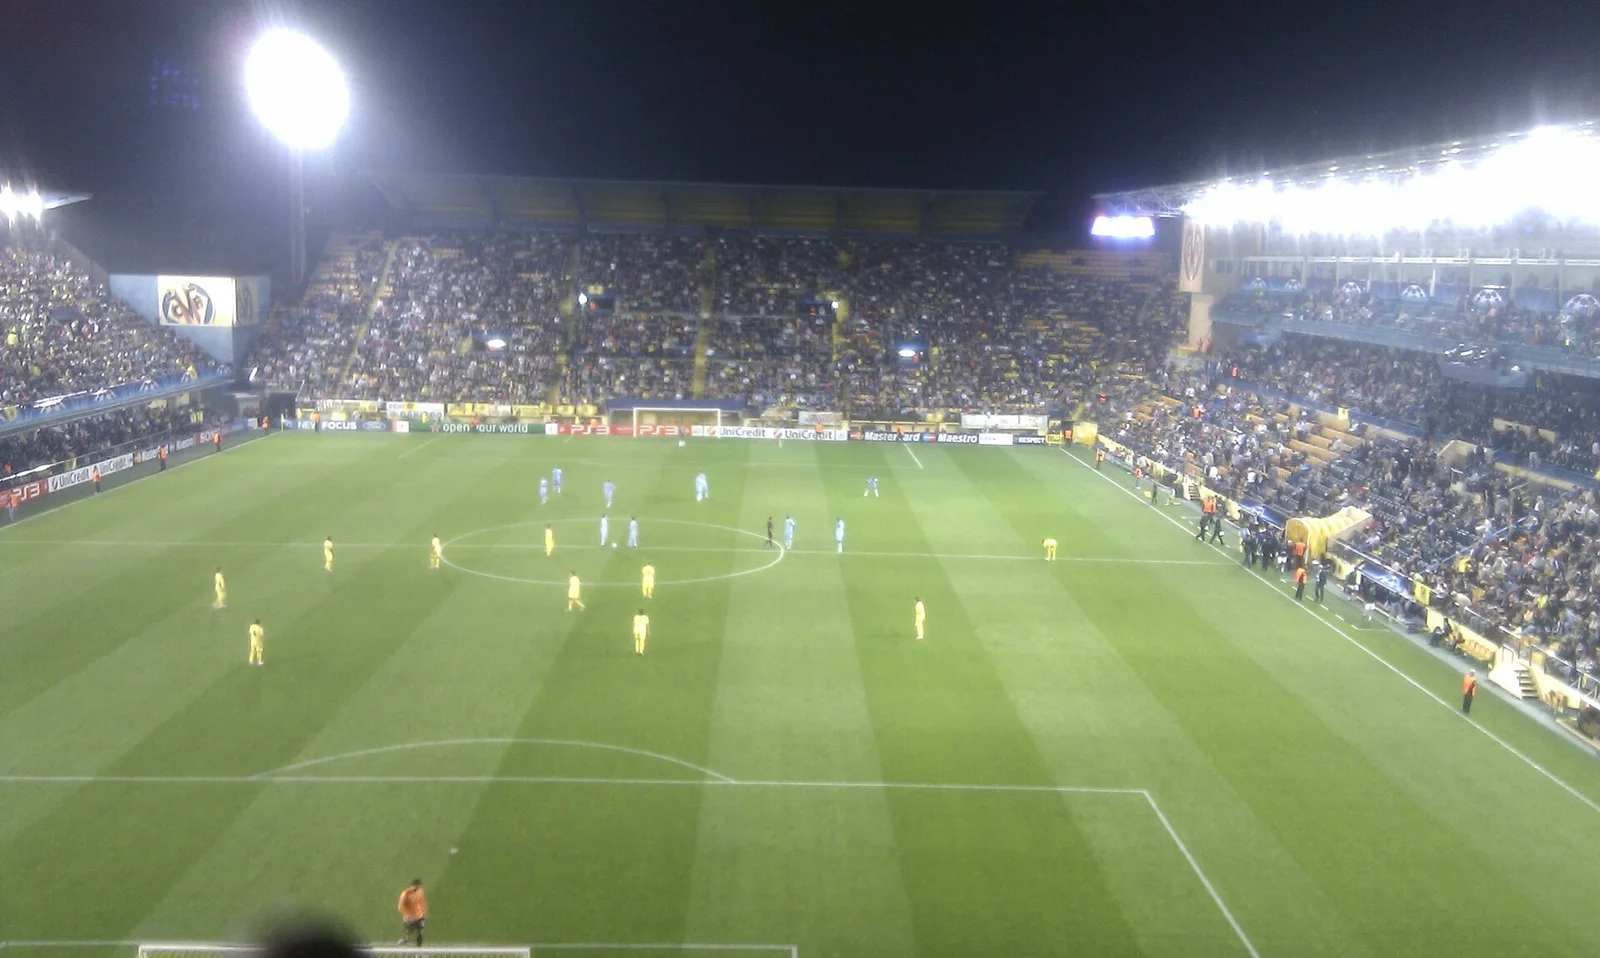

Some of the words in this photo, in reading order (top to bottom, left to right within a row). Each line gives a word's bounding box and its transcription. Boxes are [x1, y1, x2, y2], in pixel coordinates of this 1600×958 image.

[321, 421, 357, 430] FOCUS
[442, 423, 470, 434] open
[499, 423, 528, 433] world
[571, 425, 610, 435] PS3
[639, 425, 679, 435] PS3
[719, 427, 766, 438] UniCredit
[785, 429, 833, 440] UniCredit
[864, 431, 920, 442] Masterard
[937, 433, 978, 443] Maestro
[1018, 436, 1046, 444] RESPECT
[13, 482, 40, 500] PS3
